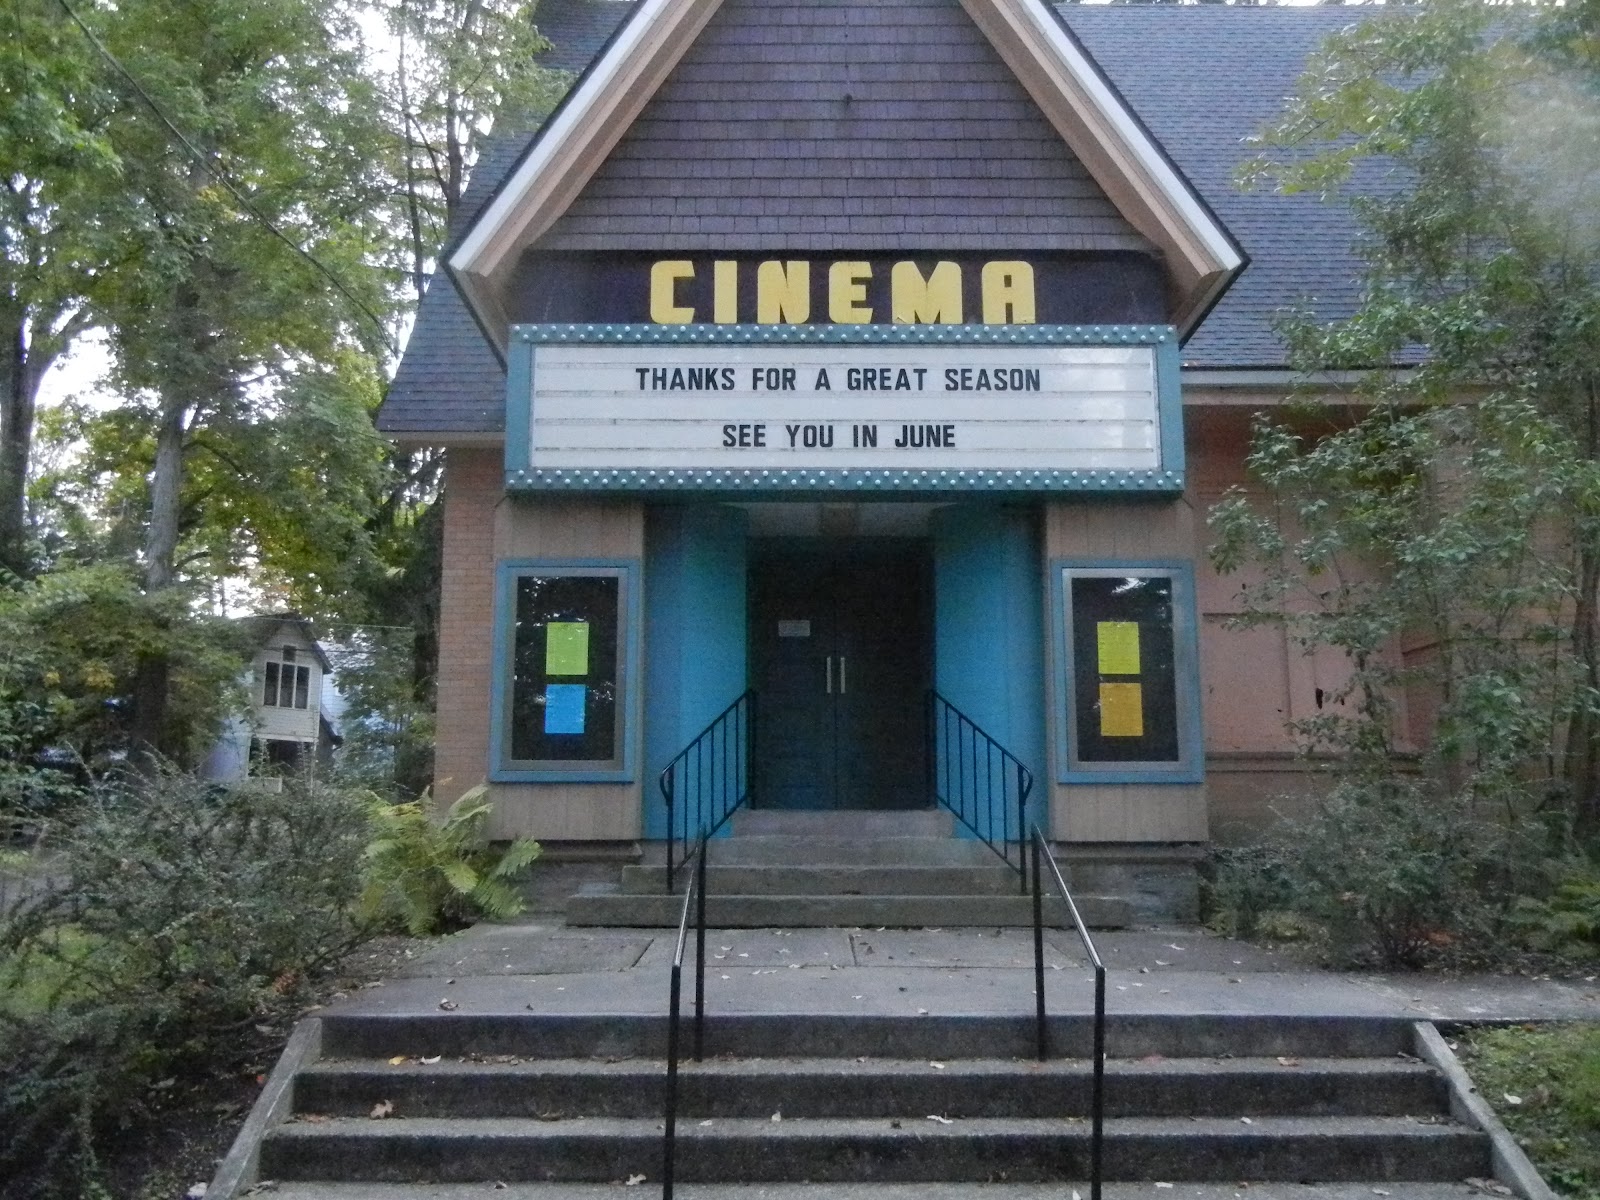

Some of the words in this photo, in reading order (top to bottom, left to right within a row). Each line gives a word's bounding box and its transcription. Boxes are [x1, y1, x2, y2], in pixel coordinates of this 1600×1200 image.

[650, 260, 1036, 325] CINEMA
[635, 367, 735, 392] THANKS
[752, 367, 796, 392] FOR
[814, 367, 831, 392] A
[847, 367, 928, 392] GREAT
[944, 367, 1041, 392] SEASON
[722, 424, 766, 448] SEE
[785, 424, 834, 448] YOU
[852, 424, 878, 448] IN
[894, 424, 956, 448] JUNE
